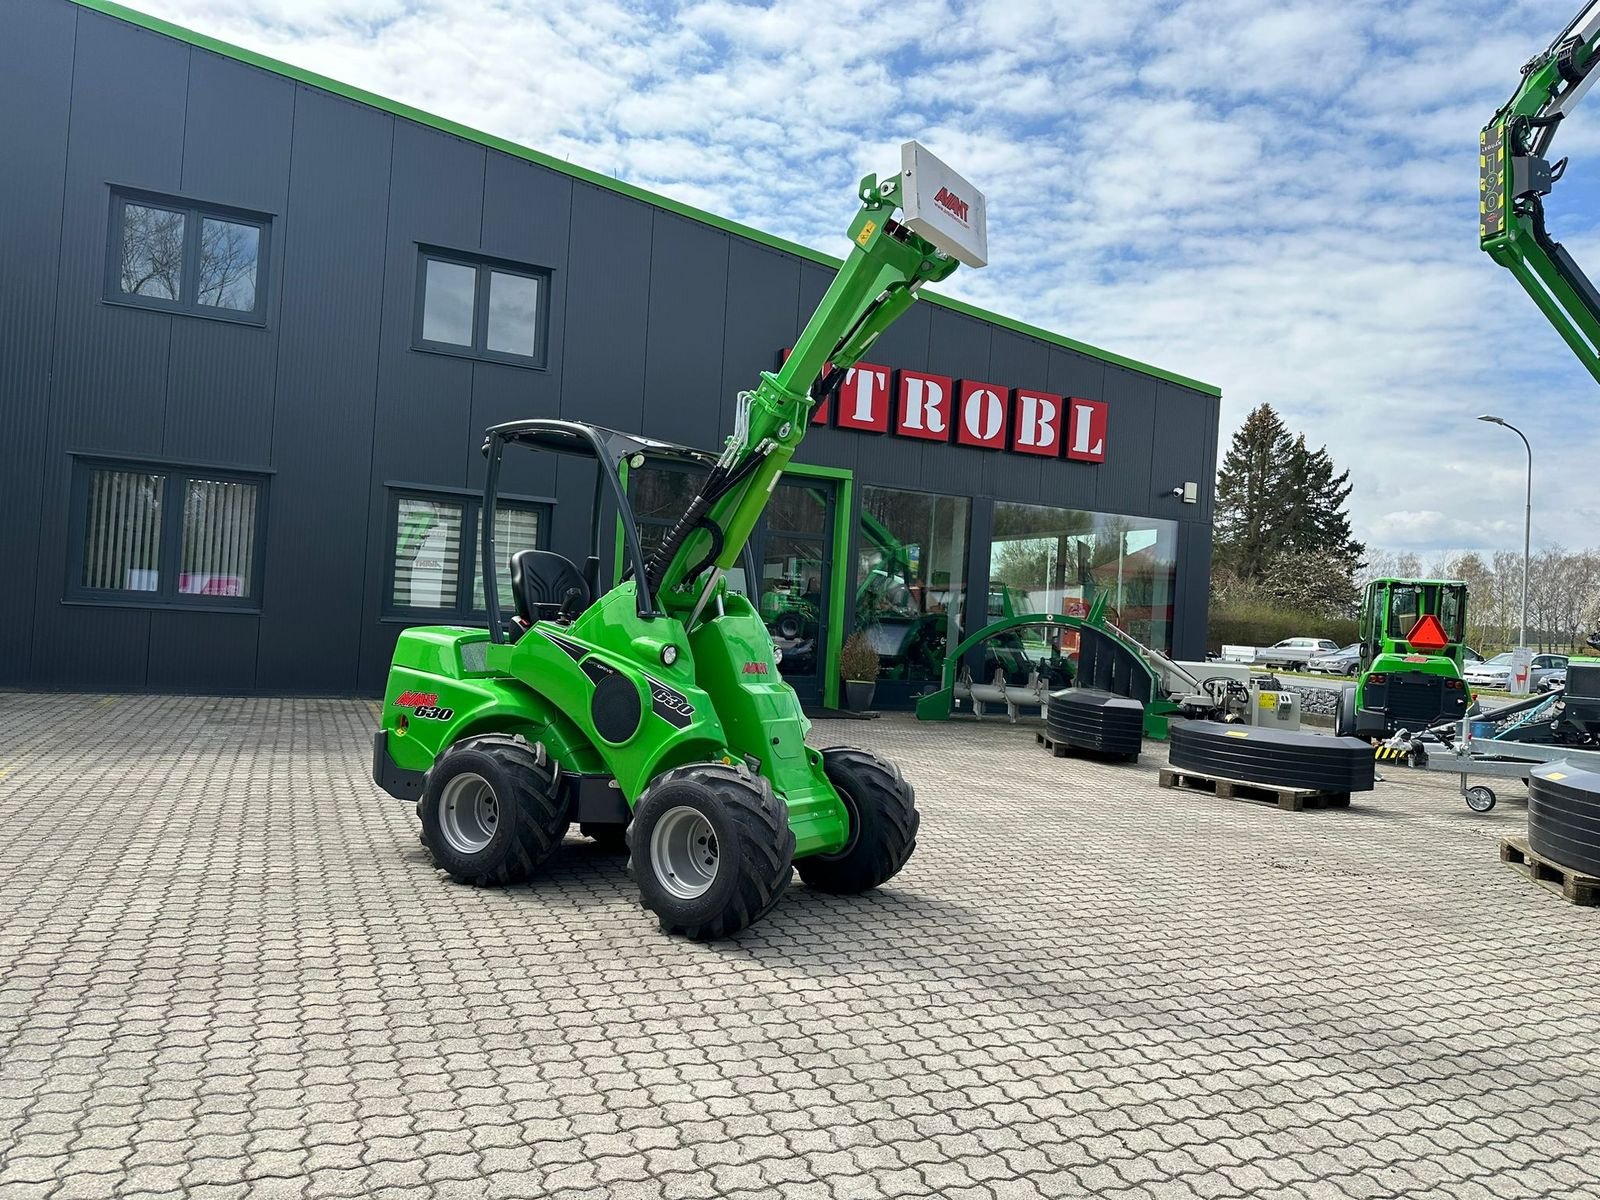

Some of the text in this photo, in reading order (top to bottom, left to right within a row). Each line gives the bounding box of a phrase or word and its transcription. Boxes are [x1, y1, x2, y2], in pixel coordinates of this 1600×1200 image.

[1485, 153, 1498, 212] 190
[934, 186, 969, 222] AVANT
[832, 366, 1103, 455] TROBL
[414, 705, 455, 722] 630
[652, 688, 695, 716] 630
